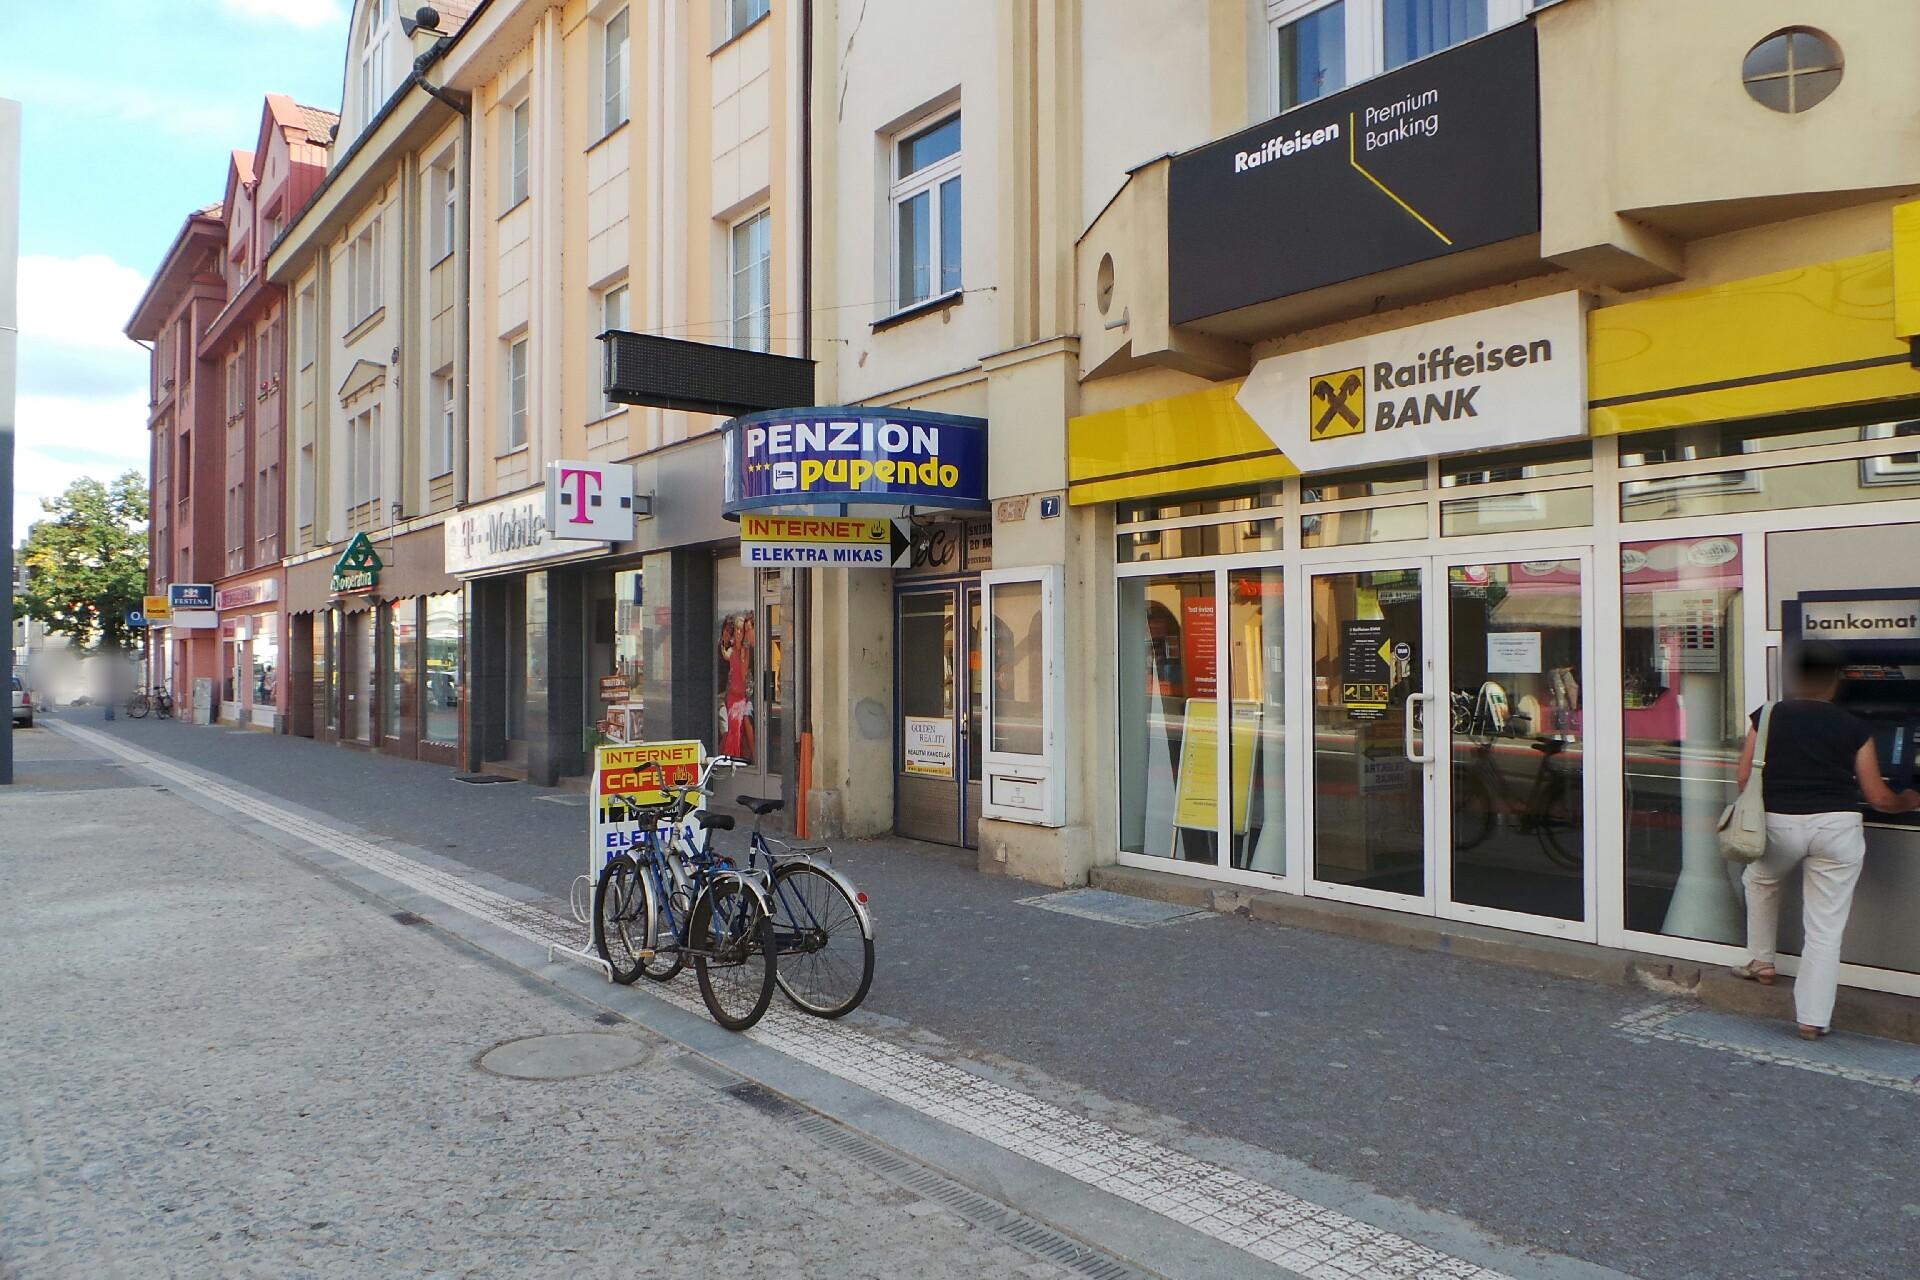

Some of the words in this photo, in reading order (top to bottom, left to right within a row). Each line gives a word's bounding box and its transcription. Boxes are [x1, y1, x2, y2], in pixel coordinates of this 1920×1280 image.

[1366, 89, 1438, 127] Premium
[1366, 114, 1438, 151] Banking
[1235, 123, 1339, 173] Raiffeisen
[1374, 339, 1552, 392] Raiffeisen
[1375, 386, 1480, 432] BANK
[747, 422, 939, 457] PENZION
[800, 457, 959, 491] pupendo
[1046, 500, 1052, 515] 7
[749, 519, 865, 538] INTERNET
[752, 548, 829, 562] ELEKTRA
[833, 548, 883, 562] MIKAS
[1805, 613, 1917, 630] bankomat
[911, 724, 936, 734] GOLDEN
[606, 748, 694, 764] INTERNET
[606, 770, 666, 790] CAFE
[606, 825, 695, 848] ELETA
